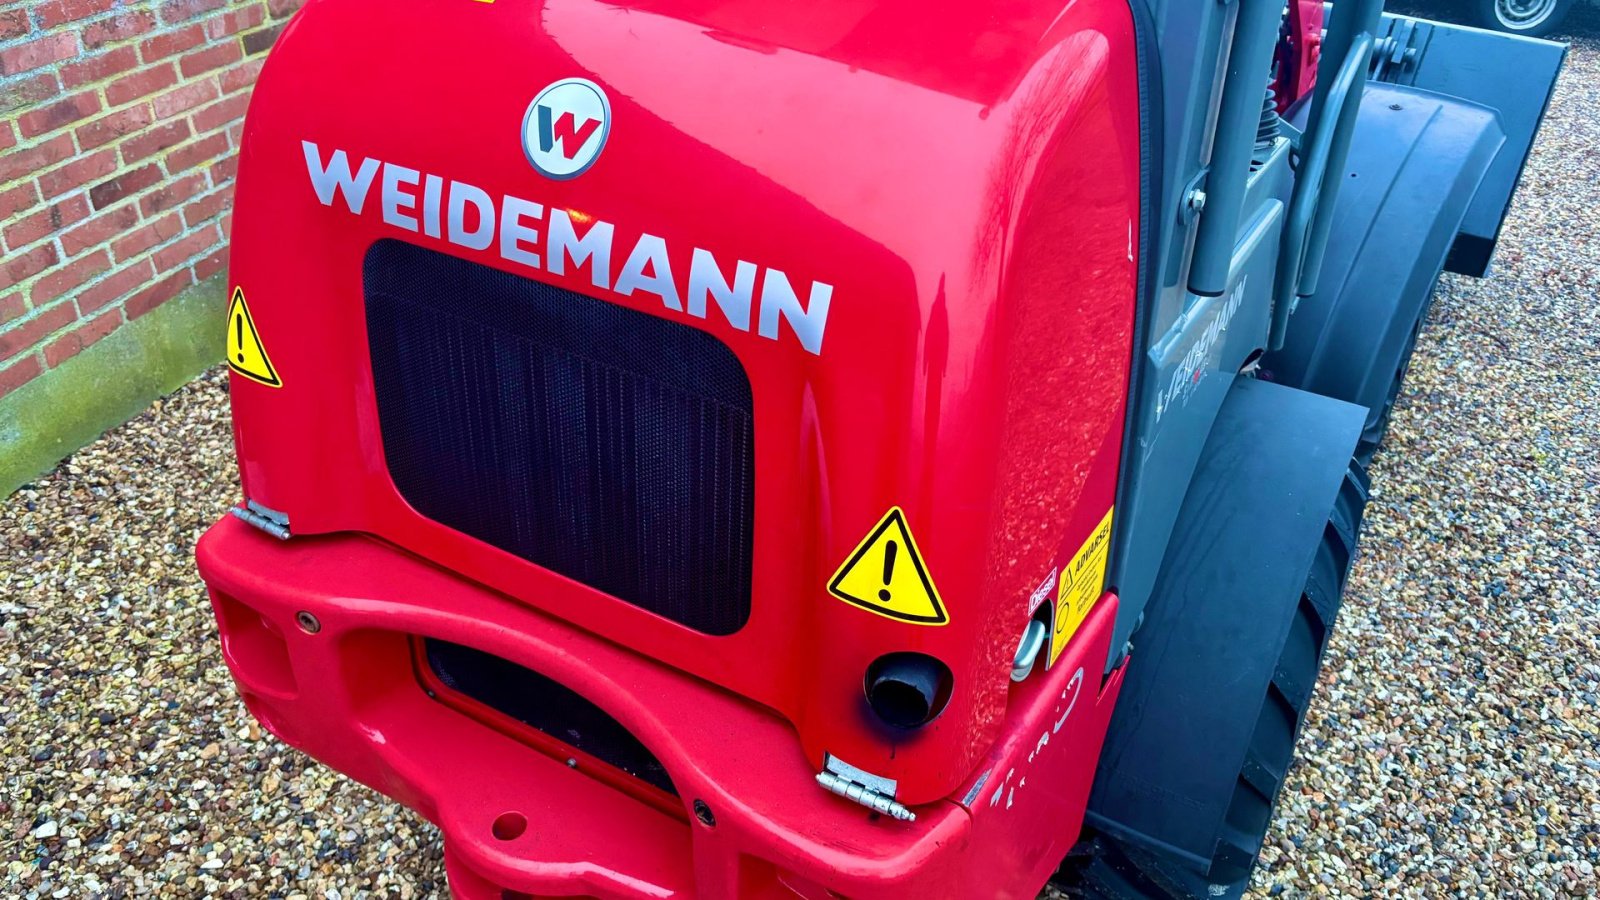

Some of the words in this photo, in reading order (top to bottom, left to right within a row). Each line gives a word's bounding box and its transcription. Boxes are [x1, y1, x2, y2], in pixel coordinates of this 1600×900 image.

[537, 104, 602, 160] W
[301, 140, 834, 356] WEIDEMANN
[1074, 521, 1110, 577] ADVARSEL
[1030, 574, 1055, 609] Diesel
